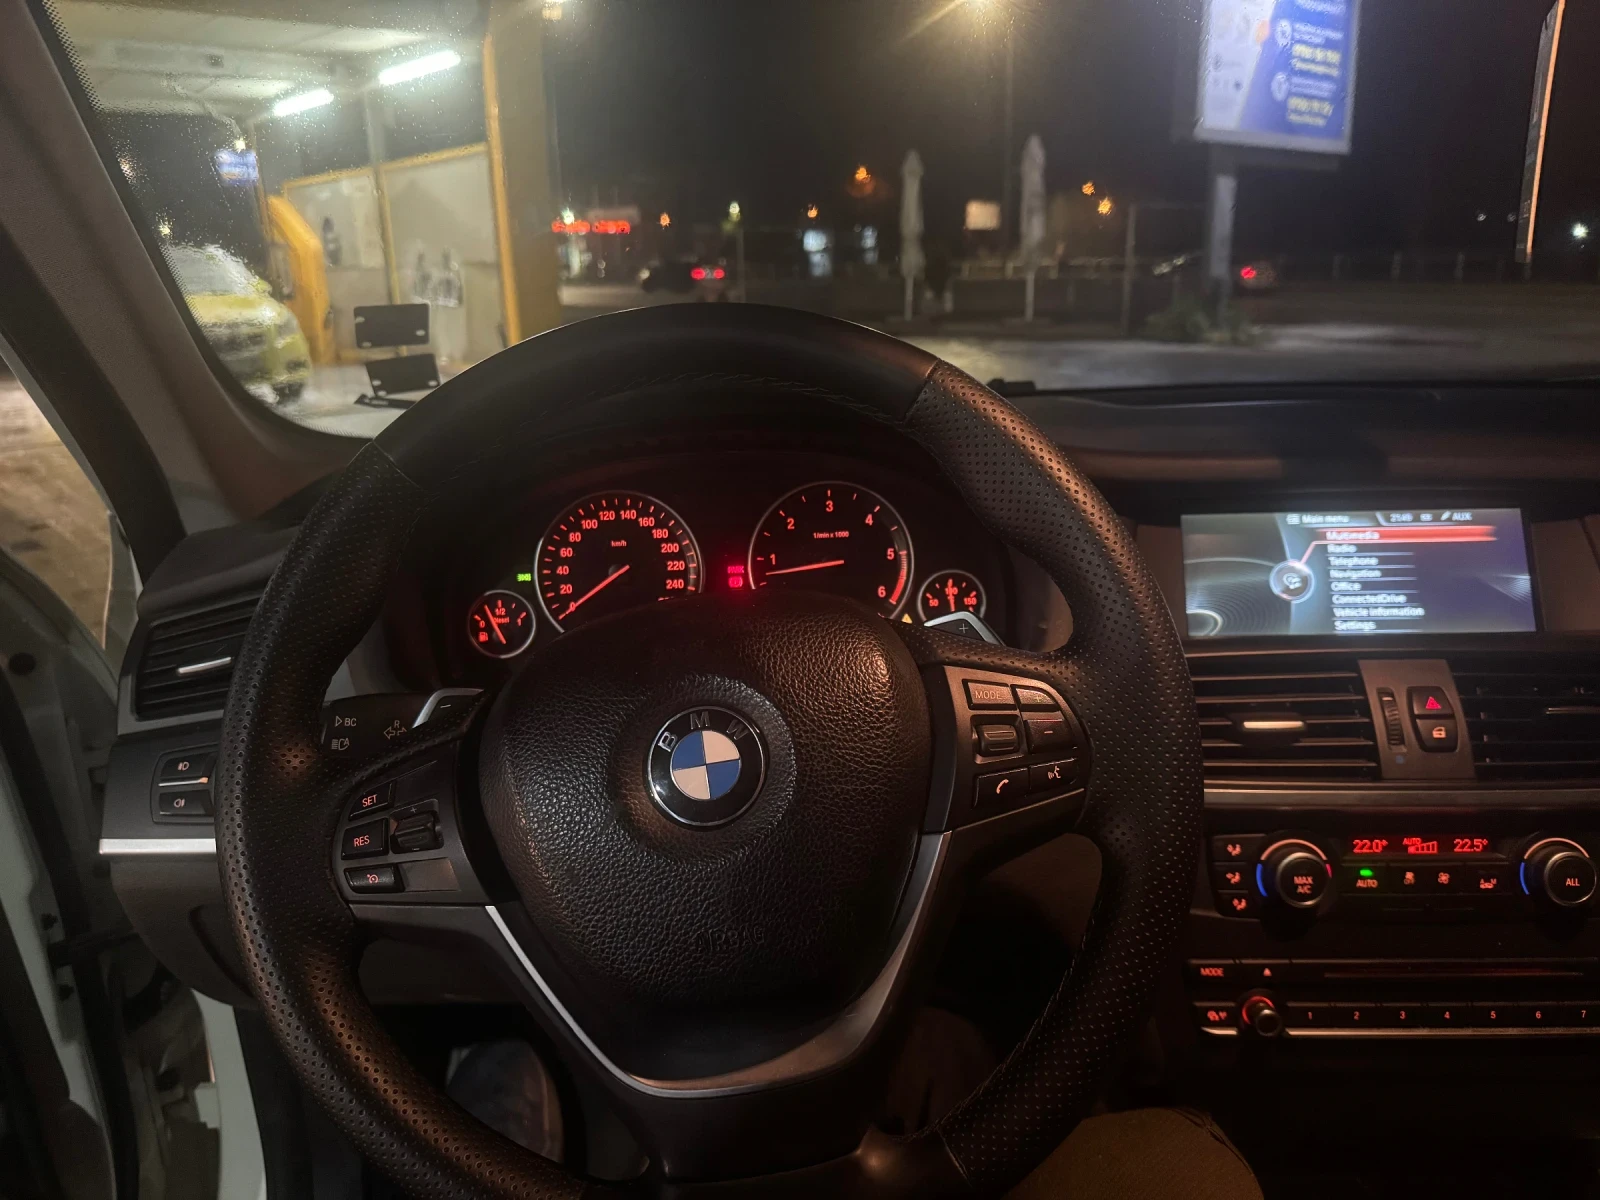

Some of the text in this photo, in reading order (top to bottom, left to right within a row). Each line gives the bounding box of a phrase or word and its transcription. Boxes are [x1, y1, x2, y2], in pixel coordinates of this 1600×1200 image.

[826, 501, 833, 512] 3
[599, 511, 615, 520] 120
[620, 510, 636, 520] 140
[865, 514, 873, 525] 4
[1302, 514, 1349, 523] Main menu
[1452, 512, 1473, 521] AUX
[581, 520, 598, 529] 100
[638, 518, 655, 527] 160
[787, 518, 795, 530] 2
[569, 532, 581, 542] 80
[652, 529, 668, 539] 180
[560, 547, 573, 557] 60
[661, 543, 679, 553] 200
[1327, 544, 1357, 553] Radio
[887, 548, 894, 560] 5
[770, 554, 776, 565] 1
[1328, 557, 1379, 567] Telephone
[556, 566, 569, 575] 40
[667, 561, 685, 571] 220
[1329, 569, 1382, 579] Navigation
[560, 584, 572, 594] 20
[666, 579, 684, 589] 240
[1331, 581, 1362, 591] Office
[878, 586, 886, 597] 6
[929, 599, 939, 607] 50
[964, 597, 977, 605] 150
[1332, 594, 1407, 604] ConnectedDrive
[1333, 607, 1425, 617] Vehicle information
[479, 620, 486, 628] 0
[1334, 620, 1376, 631] Settings
[975, 690, 1002, 700] MODE
[344, 717, 357, 727] BC
[394, 720, 400, 728] R
[658, 711, 749, 752] BMW
[362, 794, 377, 807] SET
[353, 835, 370, 847] RES
[1403, 837, 1422, 845] AUTO
[1294, 876, 1313, 884] MAX
[1356, 879, 1378, 888] AUTO
[1566, 878, 1580, 886] ALL
[1201, 968, 1224, 976] MODE
[1354, 1011, 1359, 1020] 2
[1400, 1011, 1406, 1019] 3
[1444, 1011, 1450, 1019] 4
[1490, 1011, 1496, 1019] 5
[1535, 1011, 1541, 1019] 6
[1581, 1010, 1587, 1018] 7
